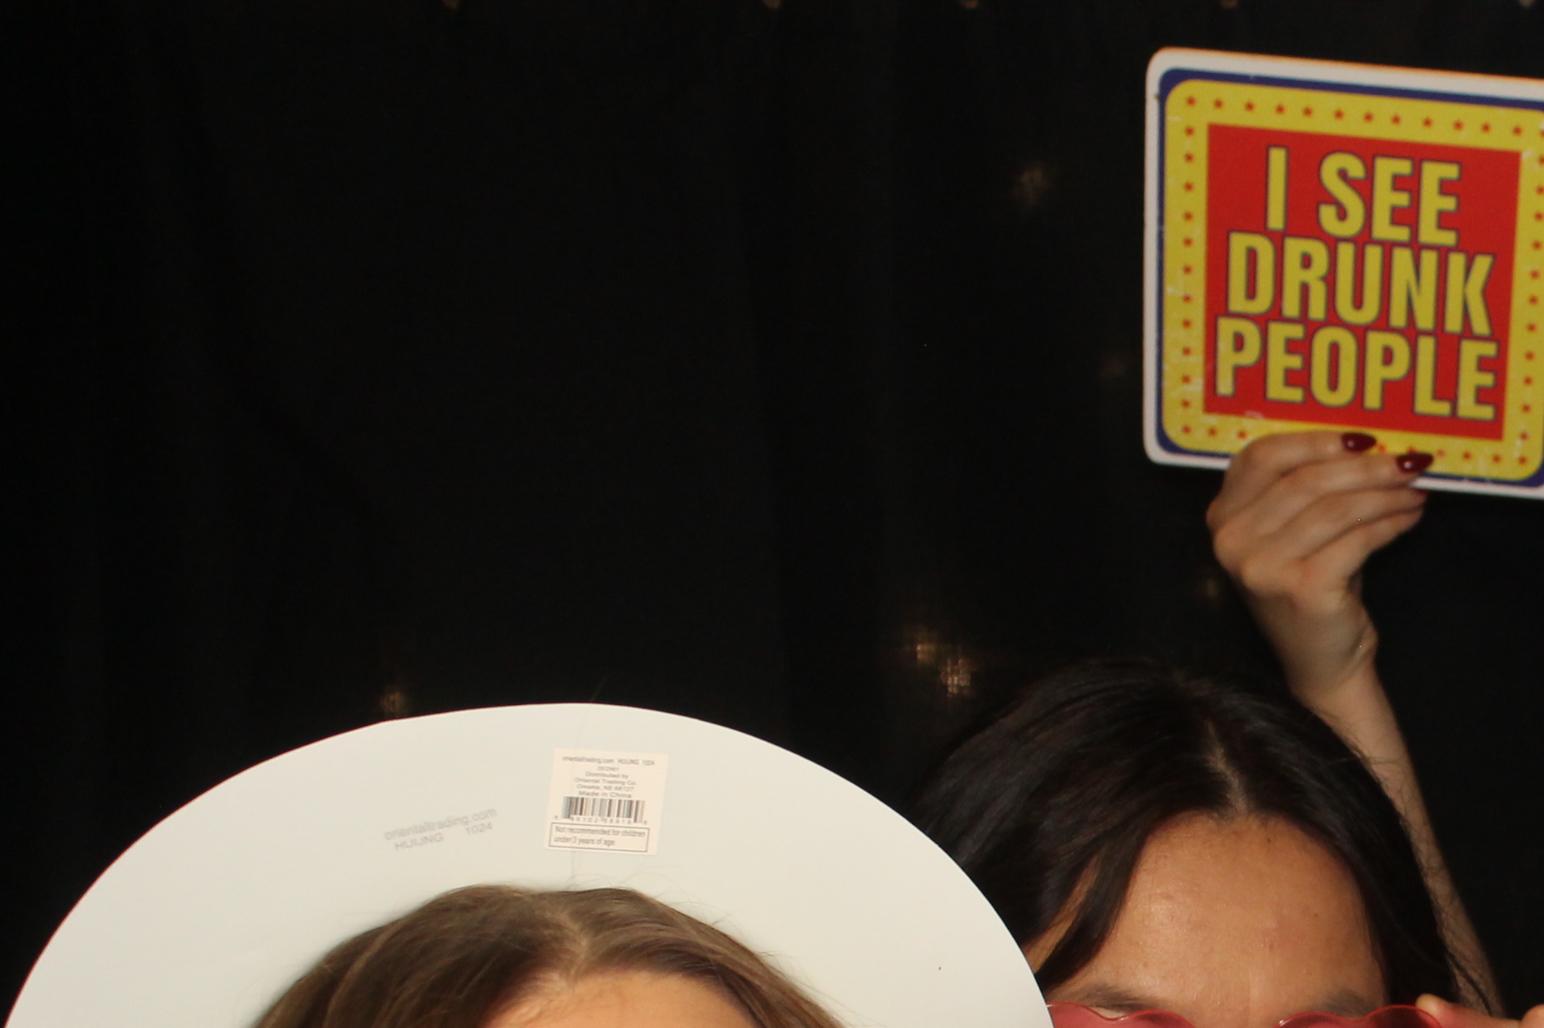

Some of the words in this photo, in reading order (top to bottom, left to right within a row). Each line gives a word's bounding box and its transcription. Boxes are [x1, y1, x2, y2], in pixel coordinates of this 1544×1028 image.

[1265, 144, 1289, 232] I
[1317, 150, 1462, 248] SEE
[1226, 230, 1497, 338] DRUNK
[1214, 314, 1500, 421] PEOPLE
[568, 827, 610, 836] recommended
